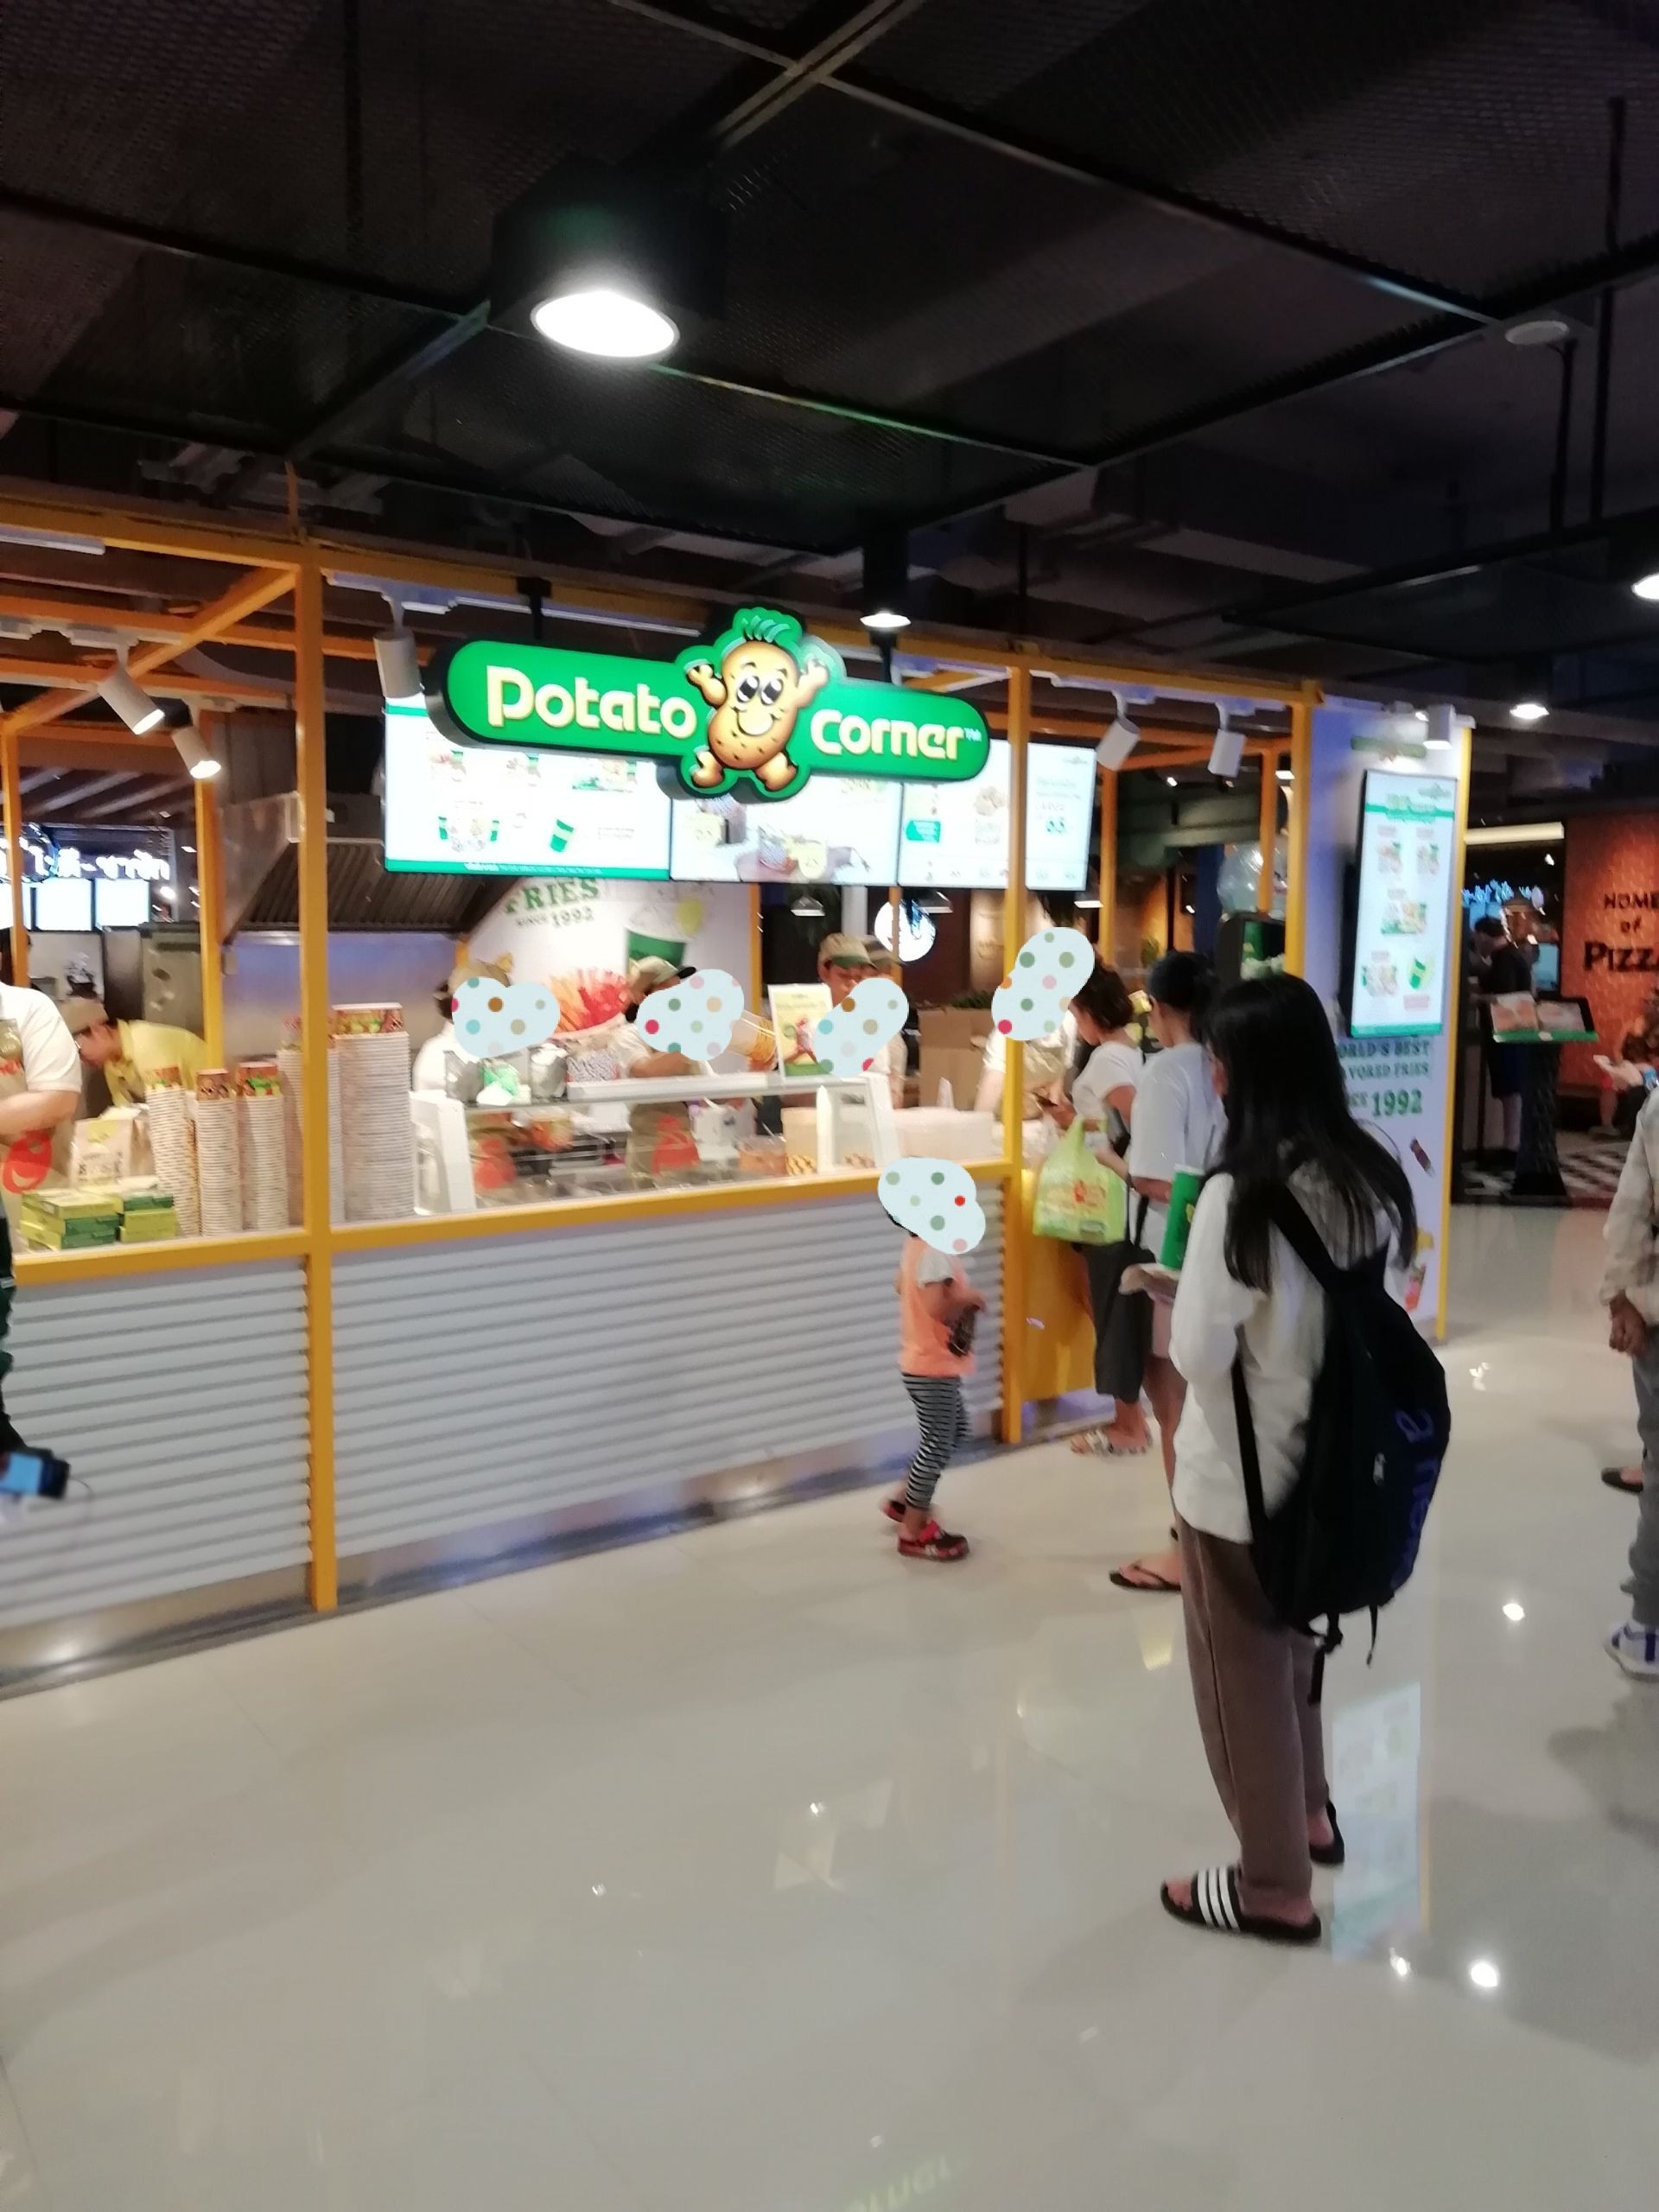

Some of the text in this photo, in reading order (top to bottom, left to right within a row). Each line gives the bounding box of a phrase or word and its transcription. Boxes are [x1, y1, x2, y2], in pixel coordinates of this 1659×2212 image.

[486, 664, 697, 740] Potato
[810, 709, 964, 760] Corner
[1604, 892, 1659, 909] HOME
[1395, 1039, 1430, 1056] BEST
[1372, 1089, 1421, 1116] 1992
